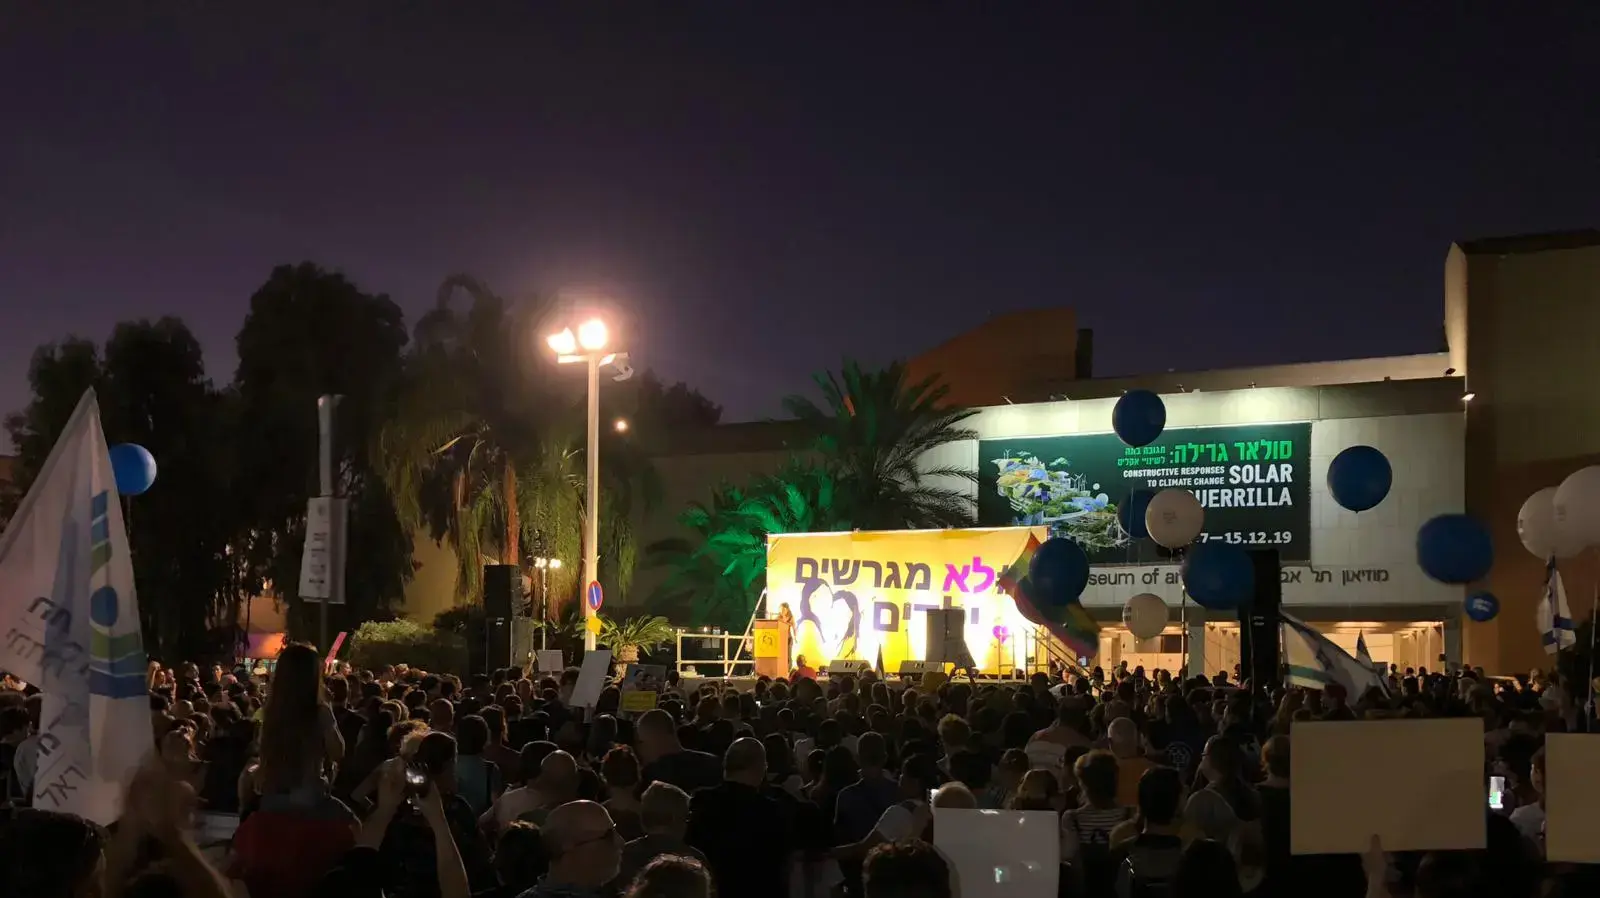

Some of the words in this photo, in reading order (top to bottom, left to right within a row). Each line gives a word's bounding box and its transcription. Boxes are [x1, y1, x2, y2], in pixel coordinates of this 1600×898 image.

[1170, 442, 1229, 464] גרילה:
[1234, 438, 1293, 461] סולאר
[1123, 467, 1180, 478] CONSTRUCTIVE
[1181, 466, 1225, 476] RESPONSES
[1147, 479, 1157, 487] TO
[1158, 477, 1193, 487] CLIMATE
[1194, 476, 1225, 485] CHANGE
[1229, 463, 1293, 484] SOLAR
[1187, 486, 1293, 508] UERRILLA
[795, 557, 932, 590] מגרשים
[1088, 572, 1135, 586] seum
[1142, 567, 1160, 585] of
[1165, 570, 1180, 585] ar
[1280, 570, 1302, 584] אב
[1310, 566, 1332, 583] תל
[1342, 569, 1390, 586] מוזיאון
